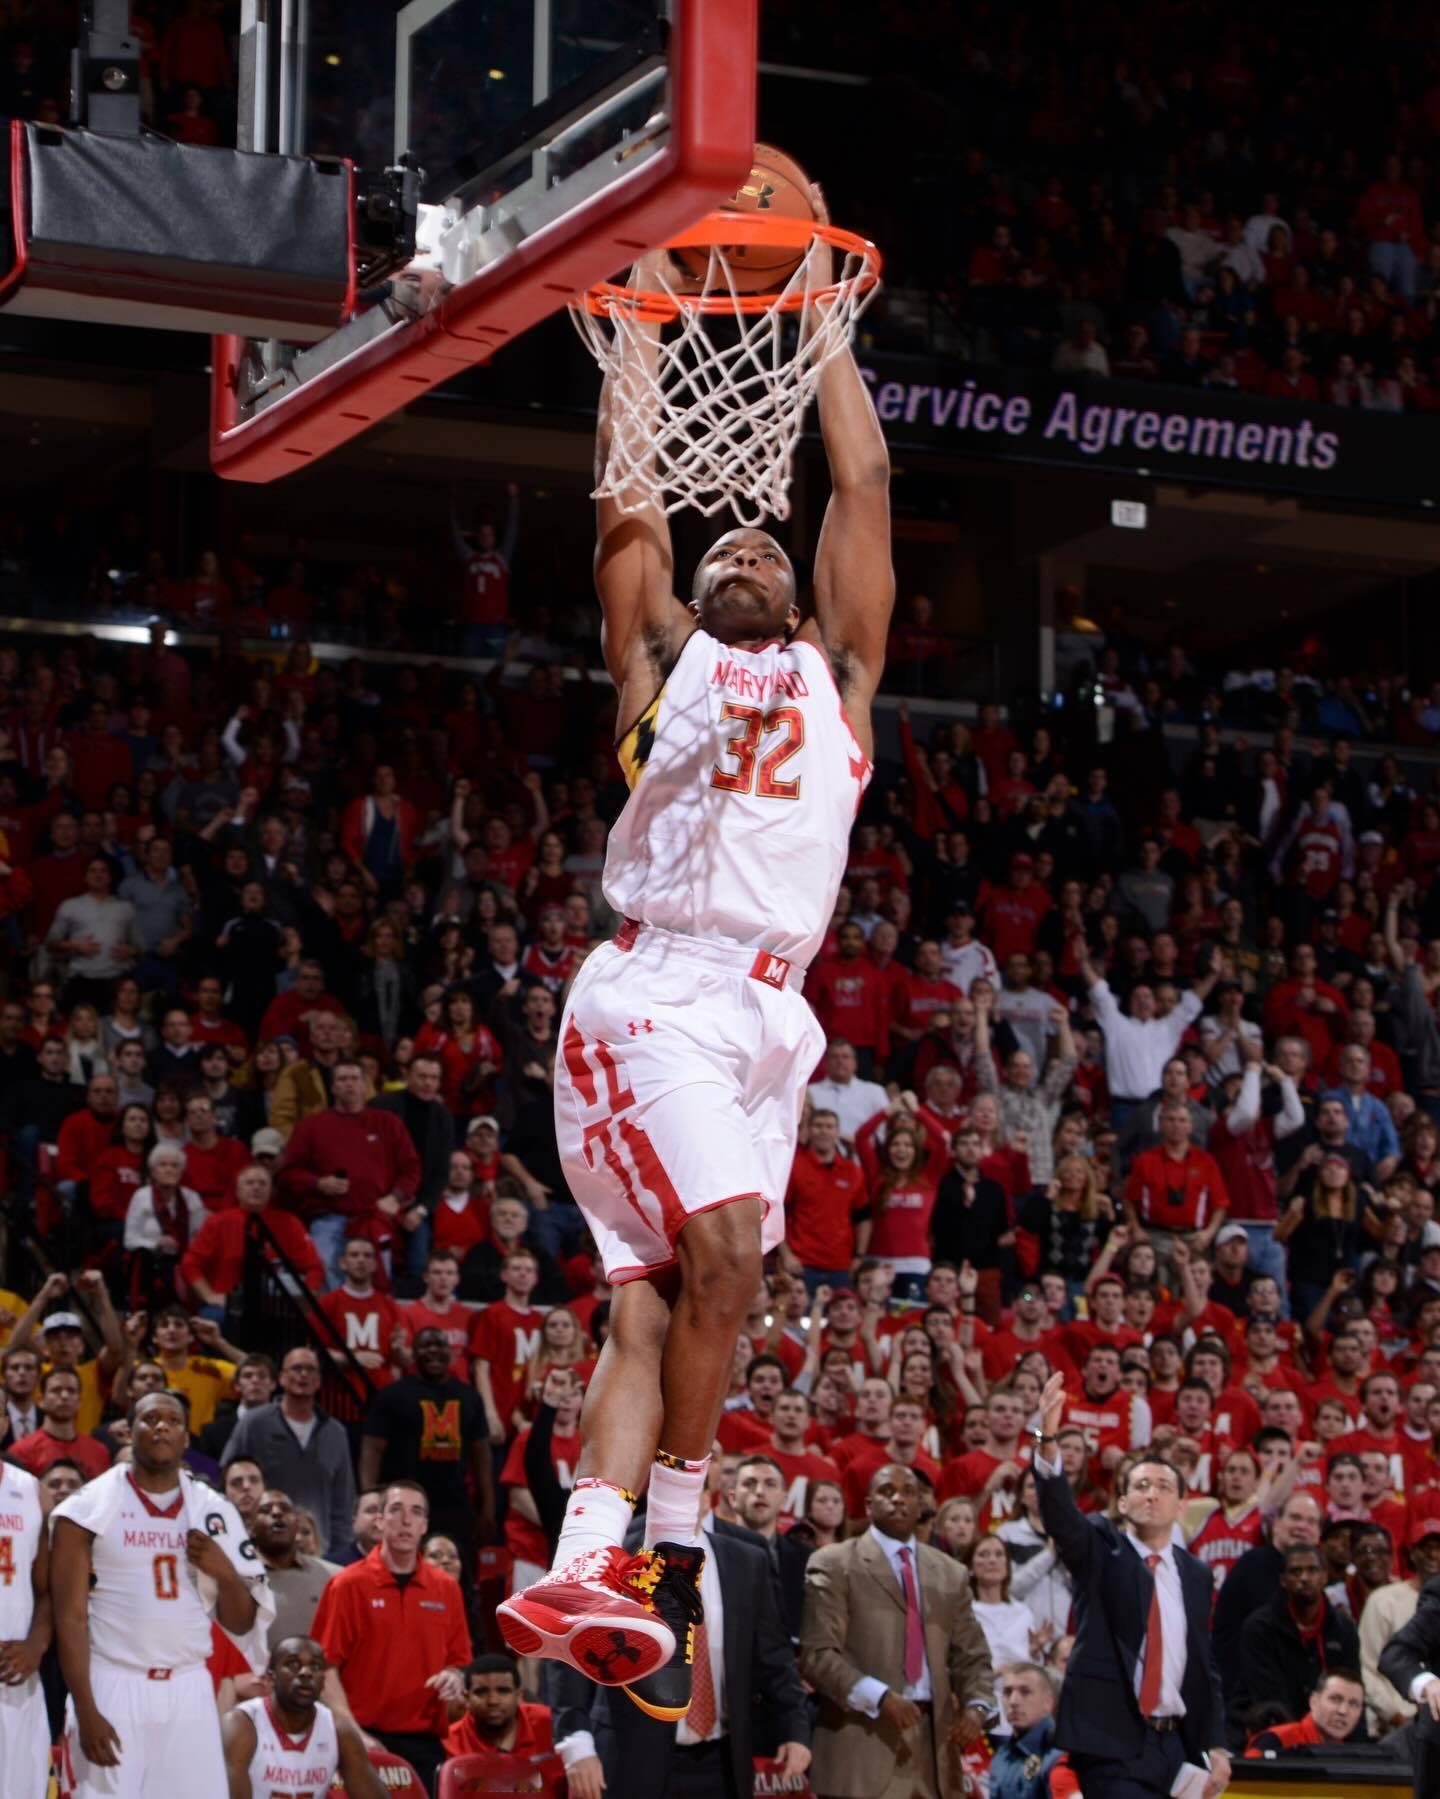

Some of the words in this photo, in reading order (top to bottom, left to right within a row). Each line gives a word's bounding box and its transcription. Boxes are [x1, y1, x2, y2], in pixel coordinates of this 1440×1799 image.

[1045, 392, 1339, 469] Agreements
[710, 701, 804, 800] 32
[763, 957, 787, 983] M
[345, 1312, 380, 1350] M
[514, 1328, 544, 1366] M
[420, 1399, 462, 1446] M
[124, 1530, 187, 1549] MARYLA
[152, 1553, 179, 1601] 0
[263, 1765, 328, 1786] MARYLAND
